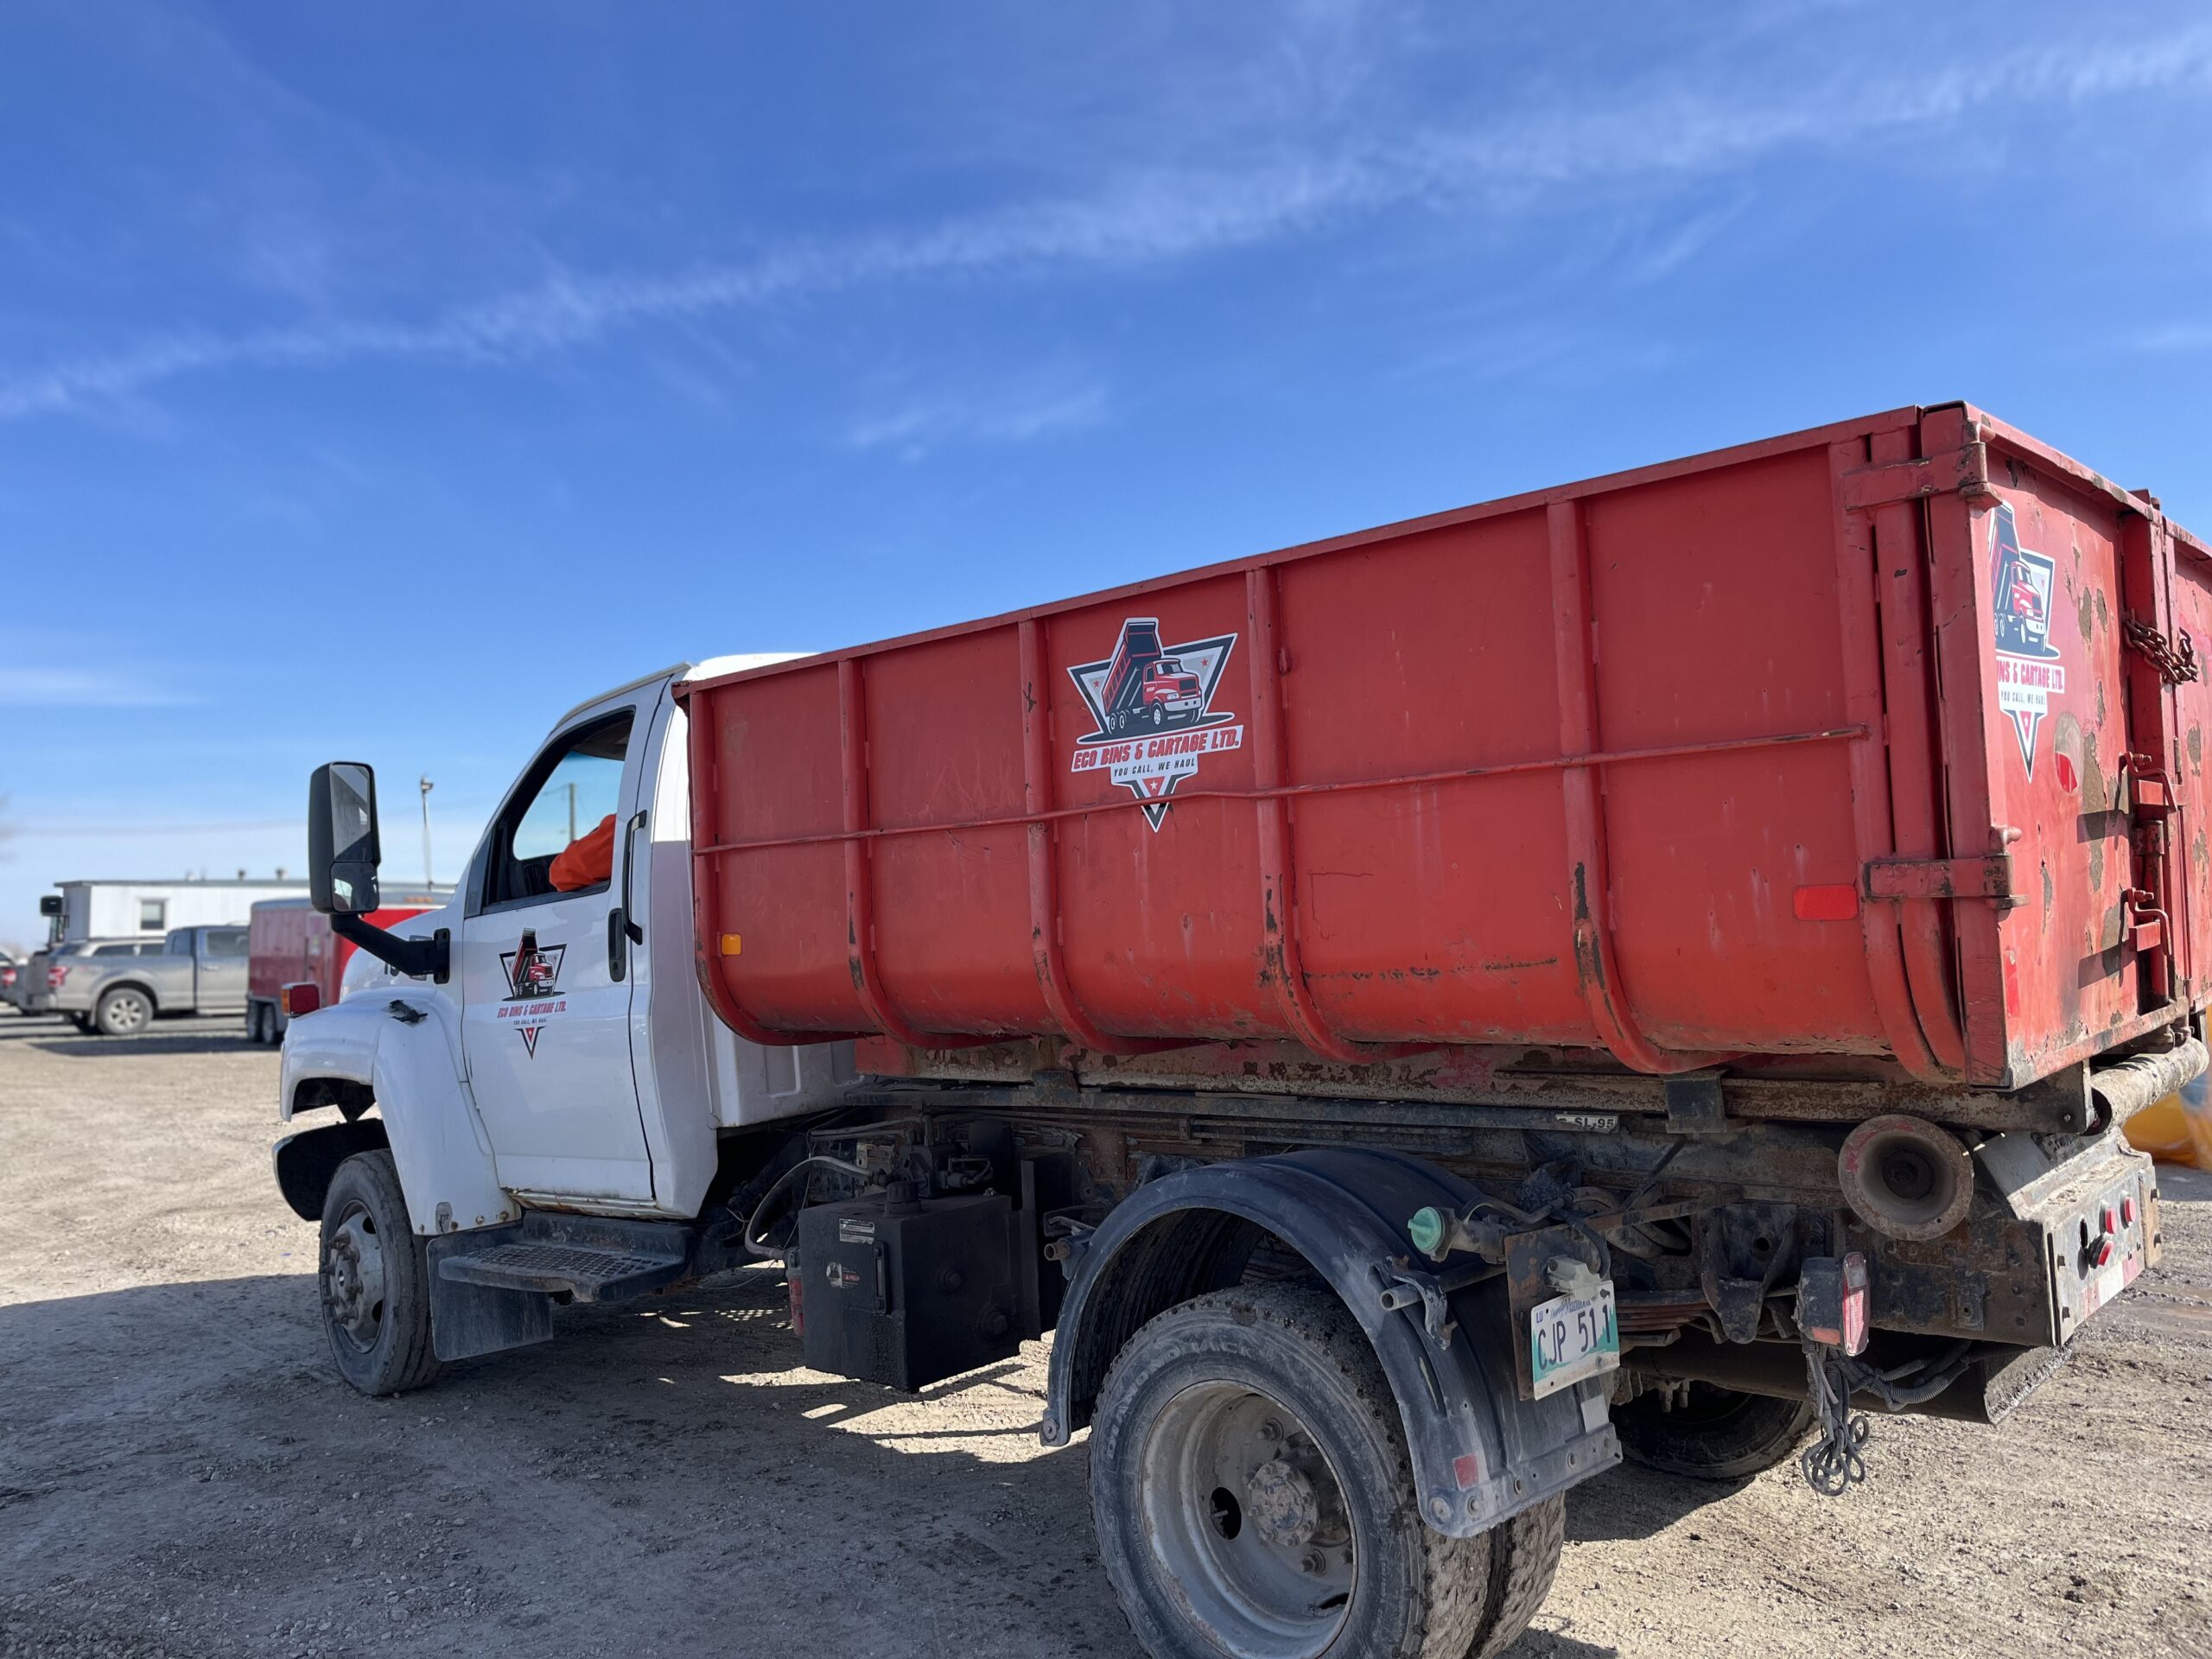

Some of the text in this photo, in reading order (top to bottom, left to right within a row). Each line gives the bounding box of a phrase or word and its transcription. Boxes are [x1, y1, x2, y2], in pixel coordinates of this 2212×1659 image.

[1997, 660, 2011, 683] INS
[2021, 664, 2050, 688] CARTAGE
[2052, 669, 2063, 690] LTD.
[1073, 729, 1239, 769] ECO BINS & CARTAGE LTD.
[1114, 758, 1195, 777] YOU CALL, WE HAUL
[1535, 1310, 1544, 1324] LU
[1538, 1320, 1566, 1370] CJP
[1578, 1304, 1610, 1352] 511
